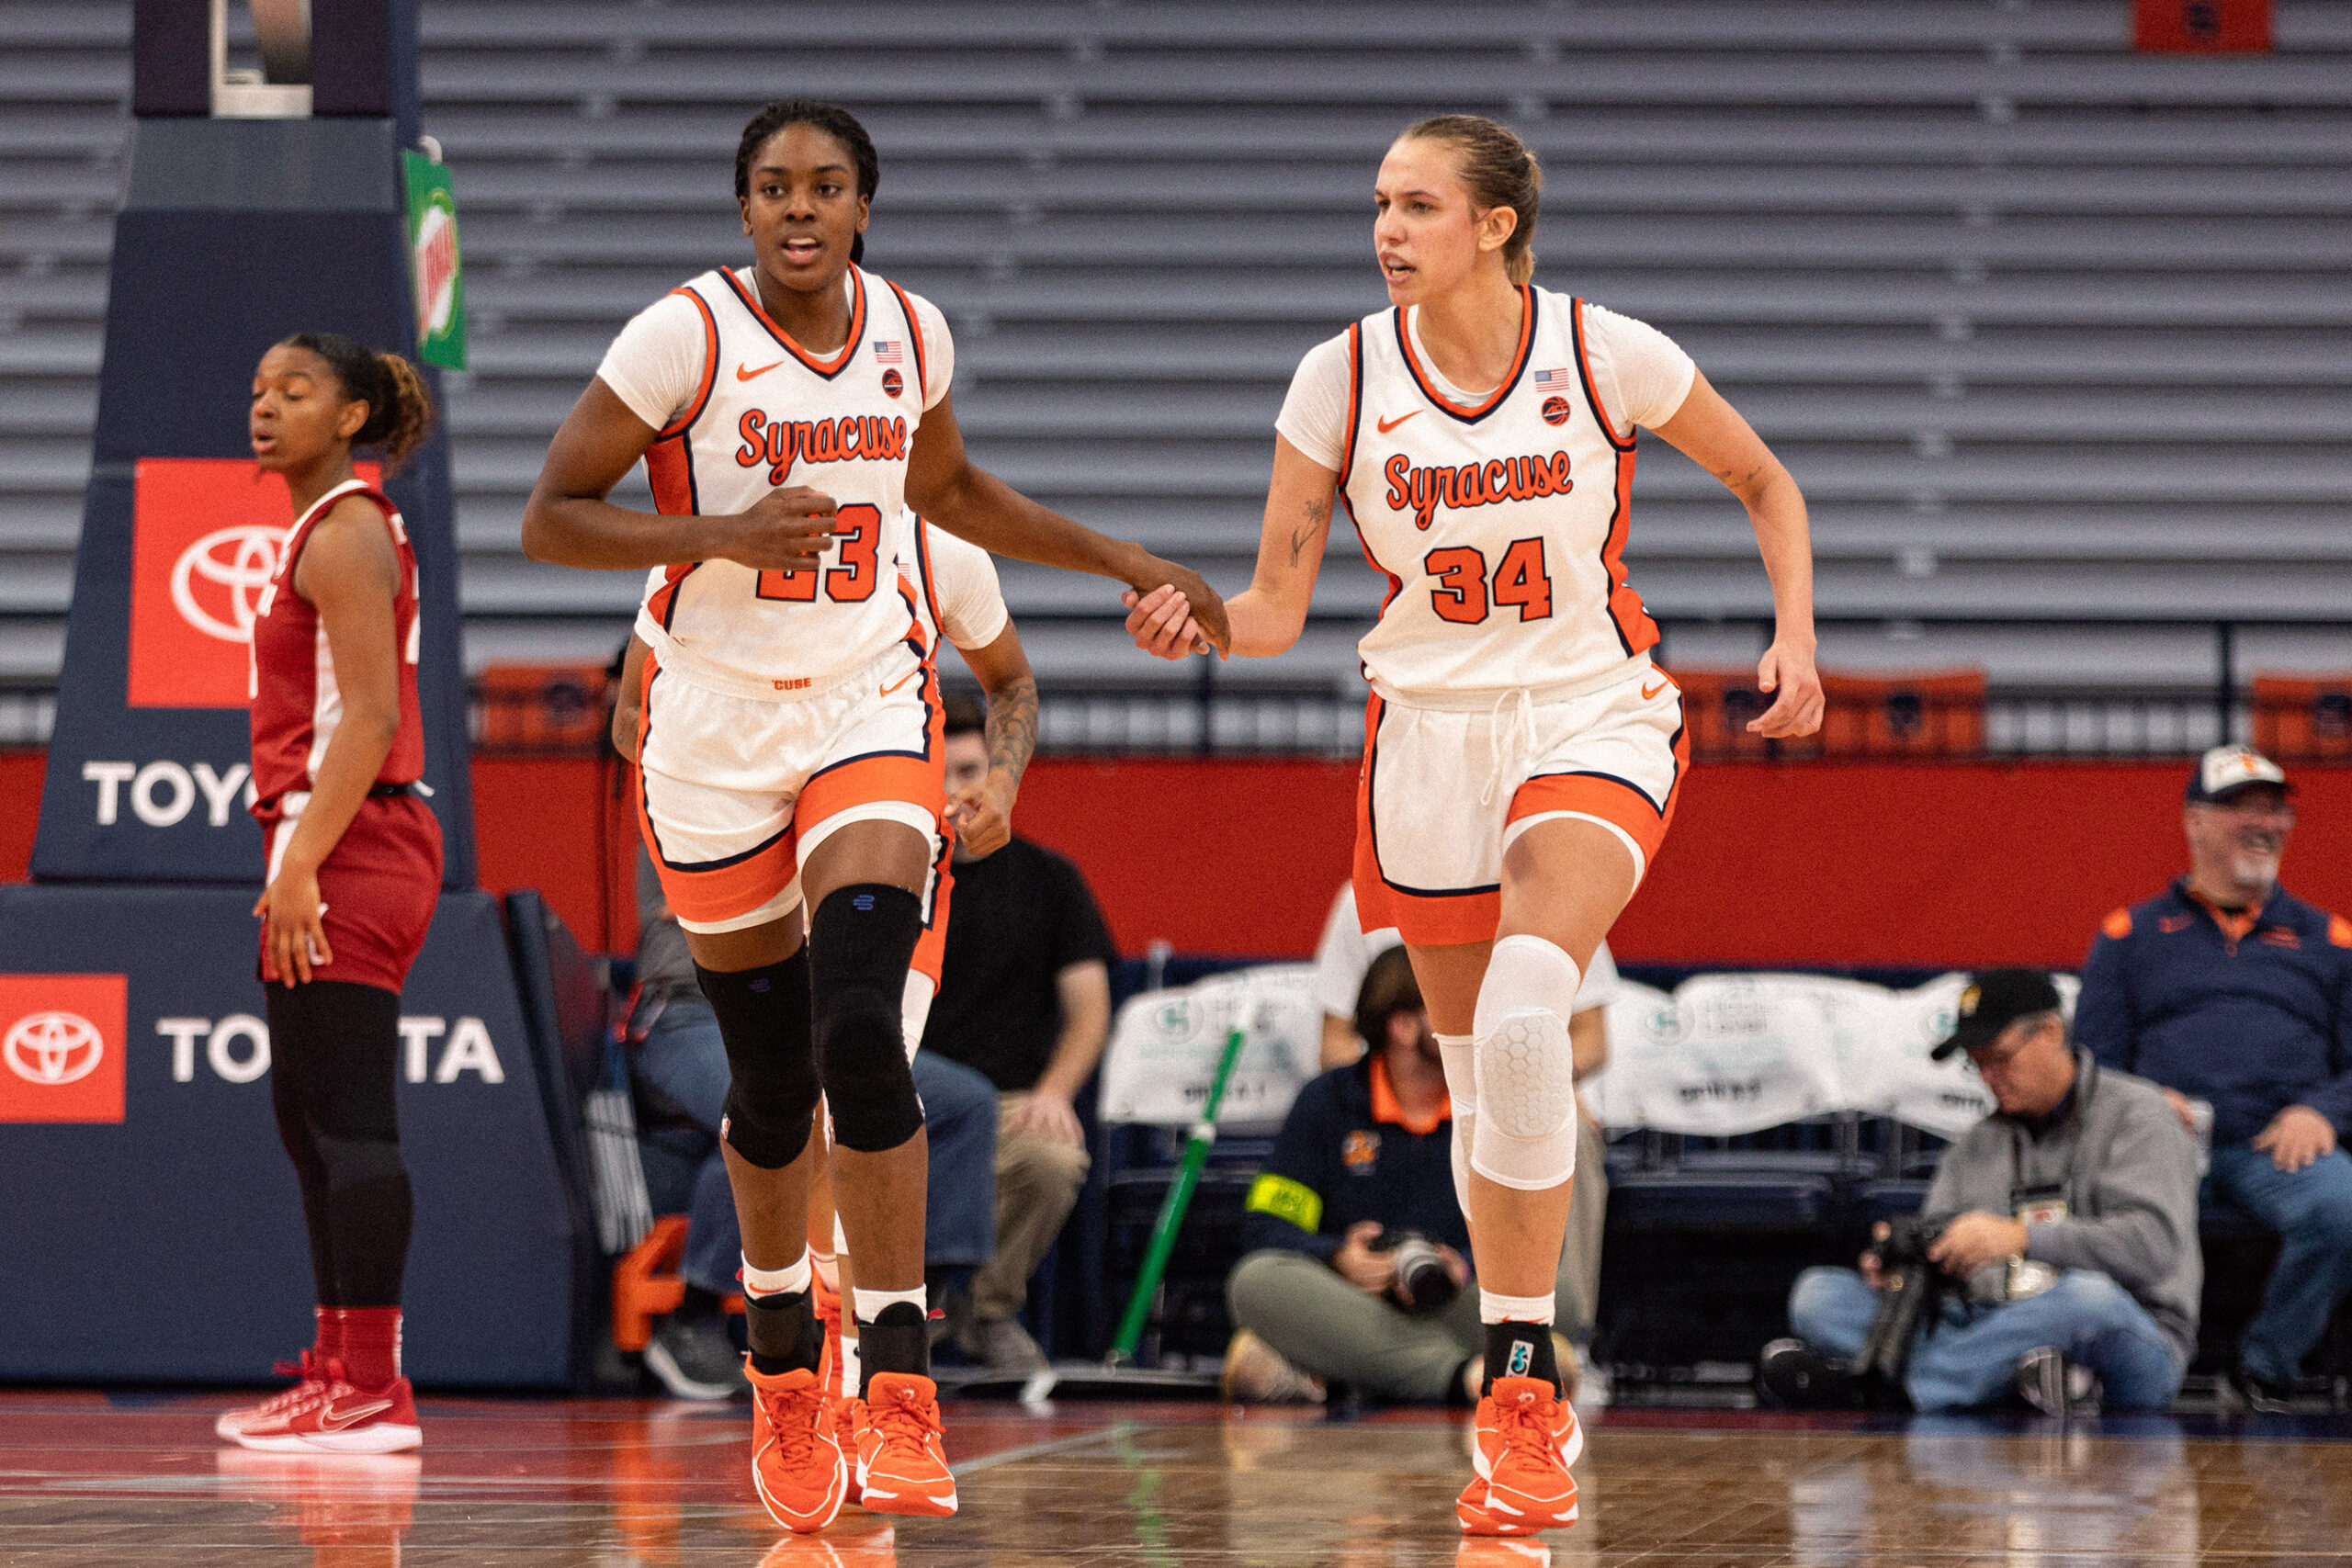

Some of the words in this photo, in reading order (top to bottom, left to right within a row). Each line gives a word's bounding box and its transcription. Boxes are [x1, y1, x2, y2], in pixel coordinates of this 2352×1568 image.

[735, 408, 907, 486] Syracuse
[1385, 449, 1573, 531] Syracuse
[1424, 536, 1553, 625] 34
[82, 760, 260, 828] TOY
[155, 1013, 505, 1084] TOTA
